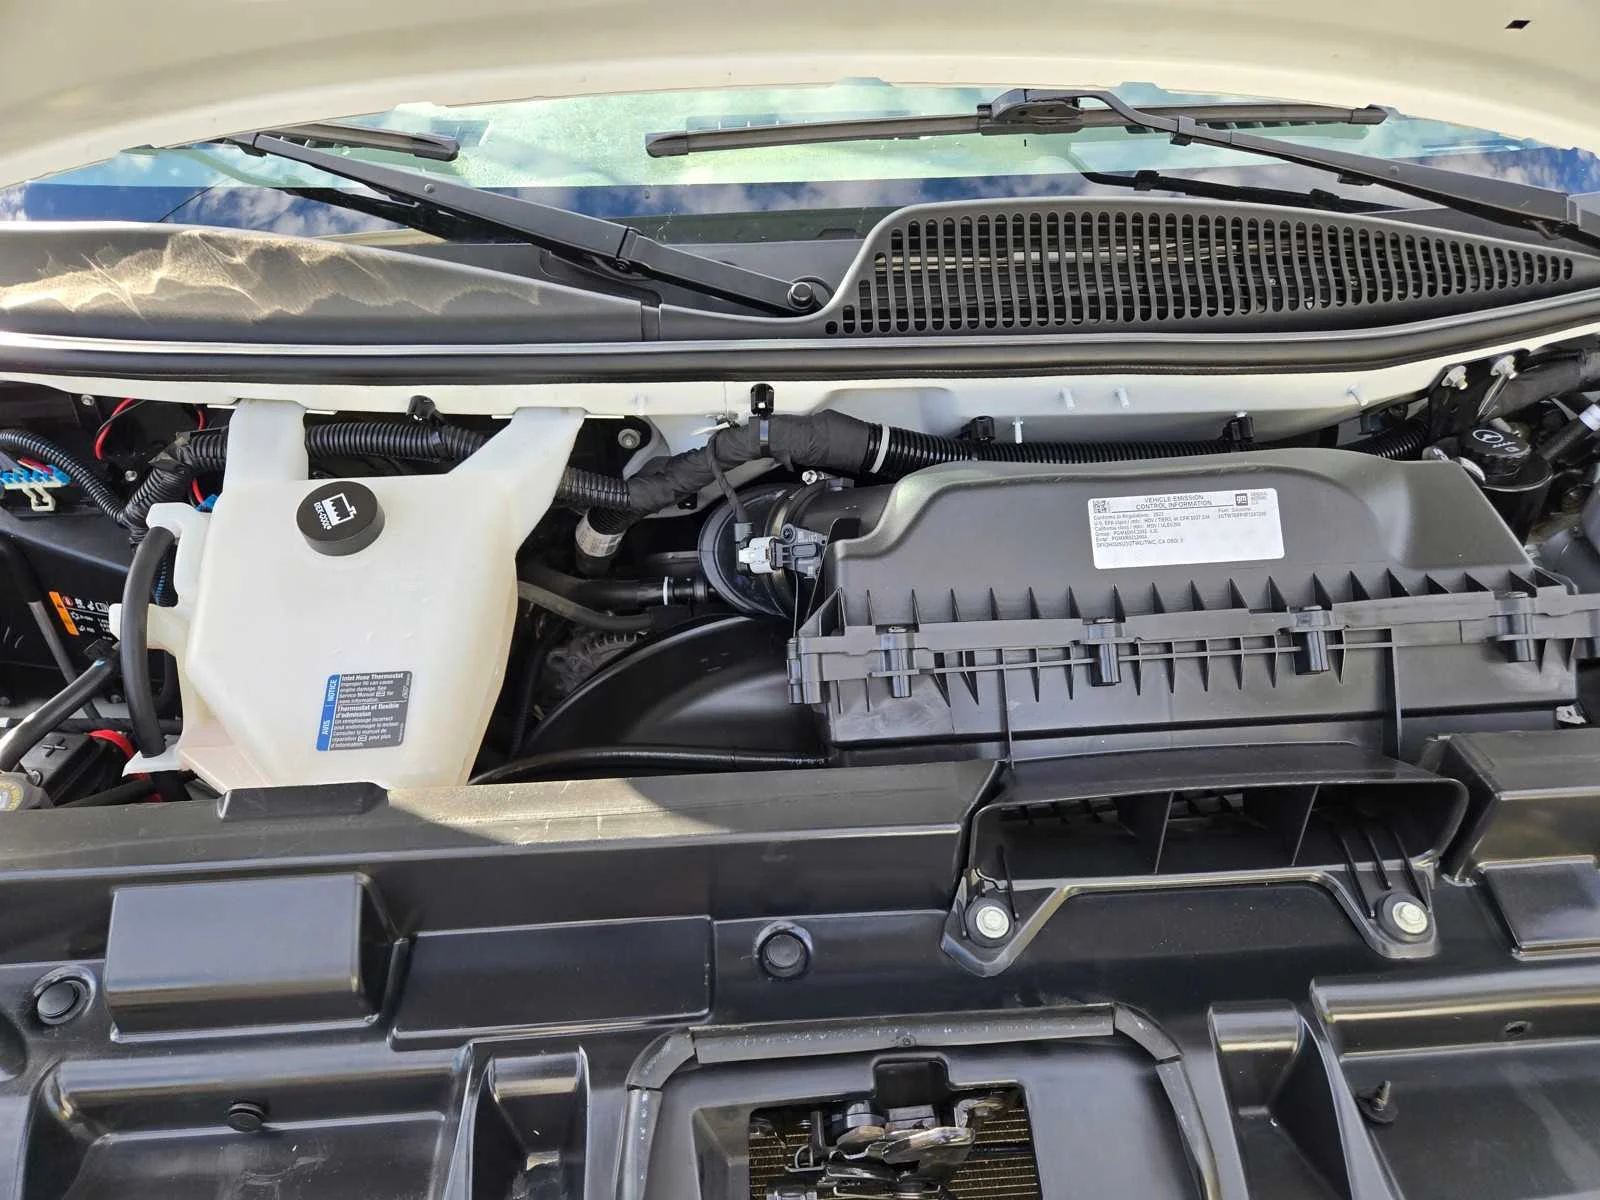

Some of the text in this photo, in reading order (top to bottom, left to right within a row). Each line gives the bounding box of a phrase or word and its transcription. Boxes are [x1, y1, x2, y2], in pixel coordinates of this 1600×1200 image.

[1172, 494, 1204, 502] EMISSION
[1135, 500, 1213, 510] CONTROL INFORMATION
[327, 678, 337, 702] NOTICE
[337, 704, 370, 712] Thermostat
[322, 719, 331, 735] AVIS
